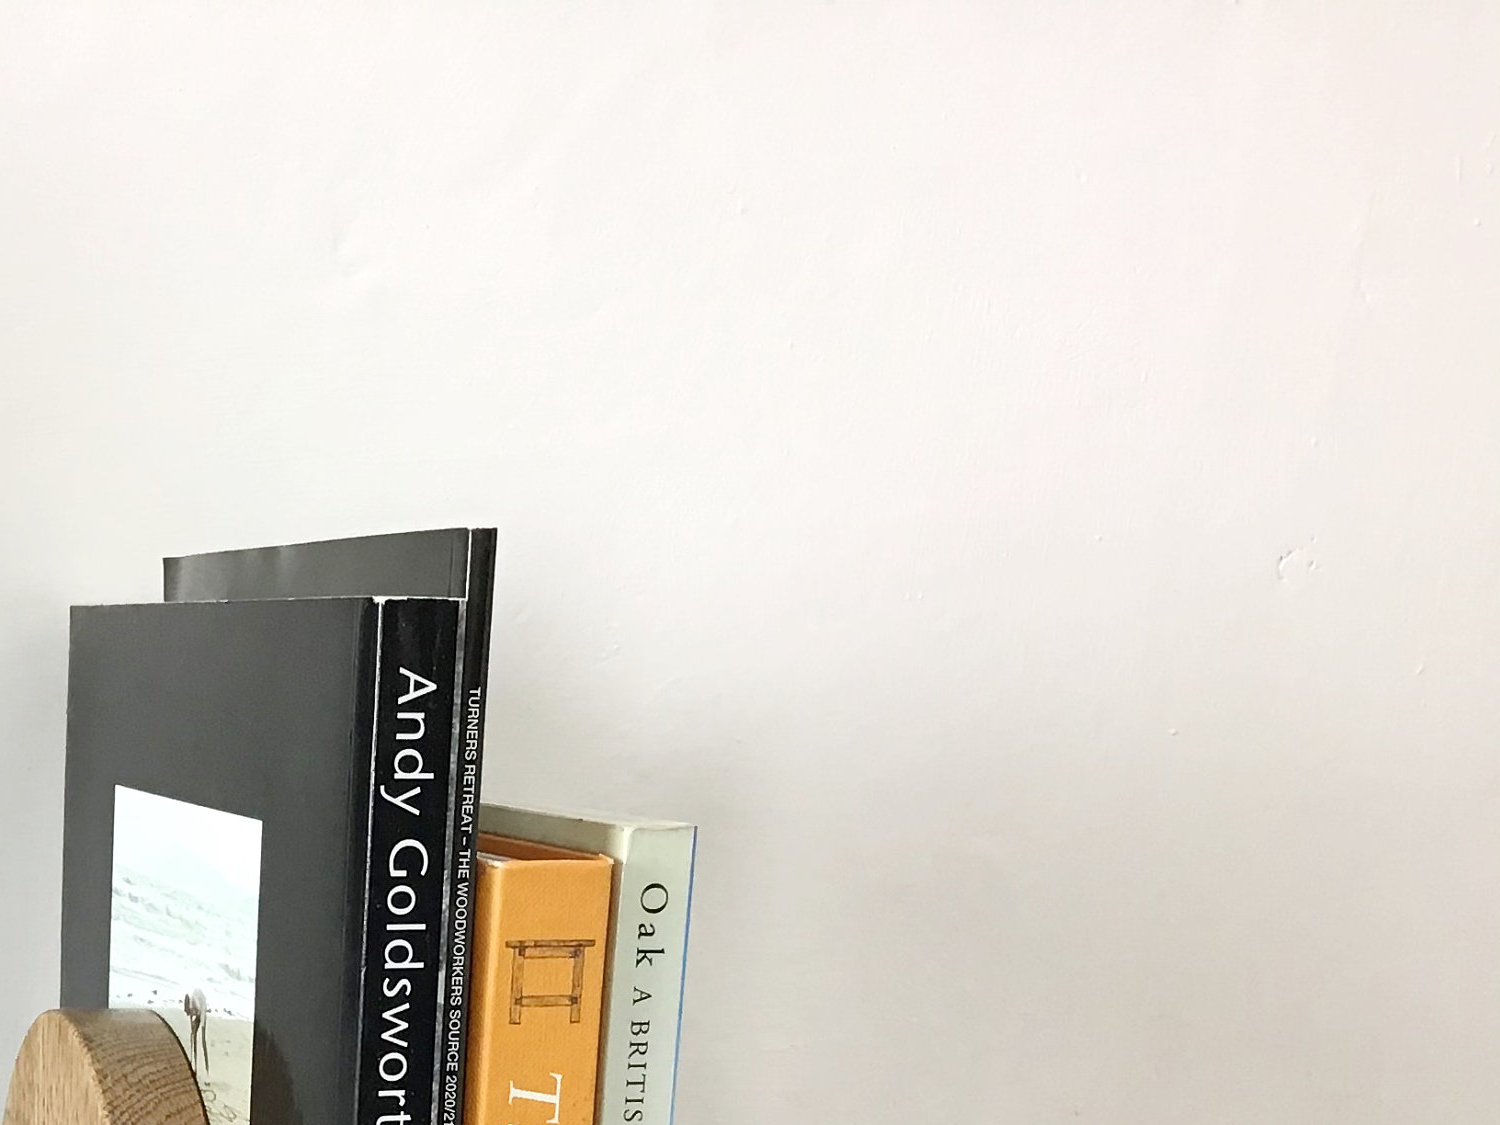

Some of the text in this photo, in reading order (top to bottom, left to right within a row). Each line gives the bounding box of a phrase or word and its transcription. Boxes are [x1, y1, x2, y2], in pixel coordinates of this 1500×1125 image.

[379, 666, 438, 816] Andy
[464, 686, 481, 761] TURNERS
[460, 763, 476, 834] RETREAT
[457, 848, 472, 879] THE
[449, 882, 470, 1006] WOODWORKERS
[635, 882, 669, 968] Oak
[632, 986, 653, 1006] A
[446, 1009, 462, 1073] SOURCE
